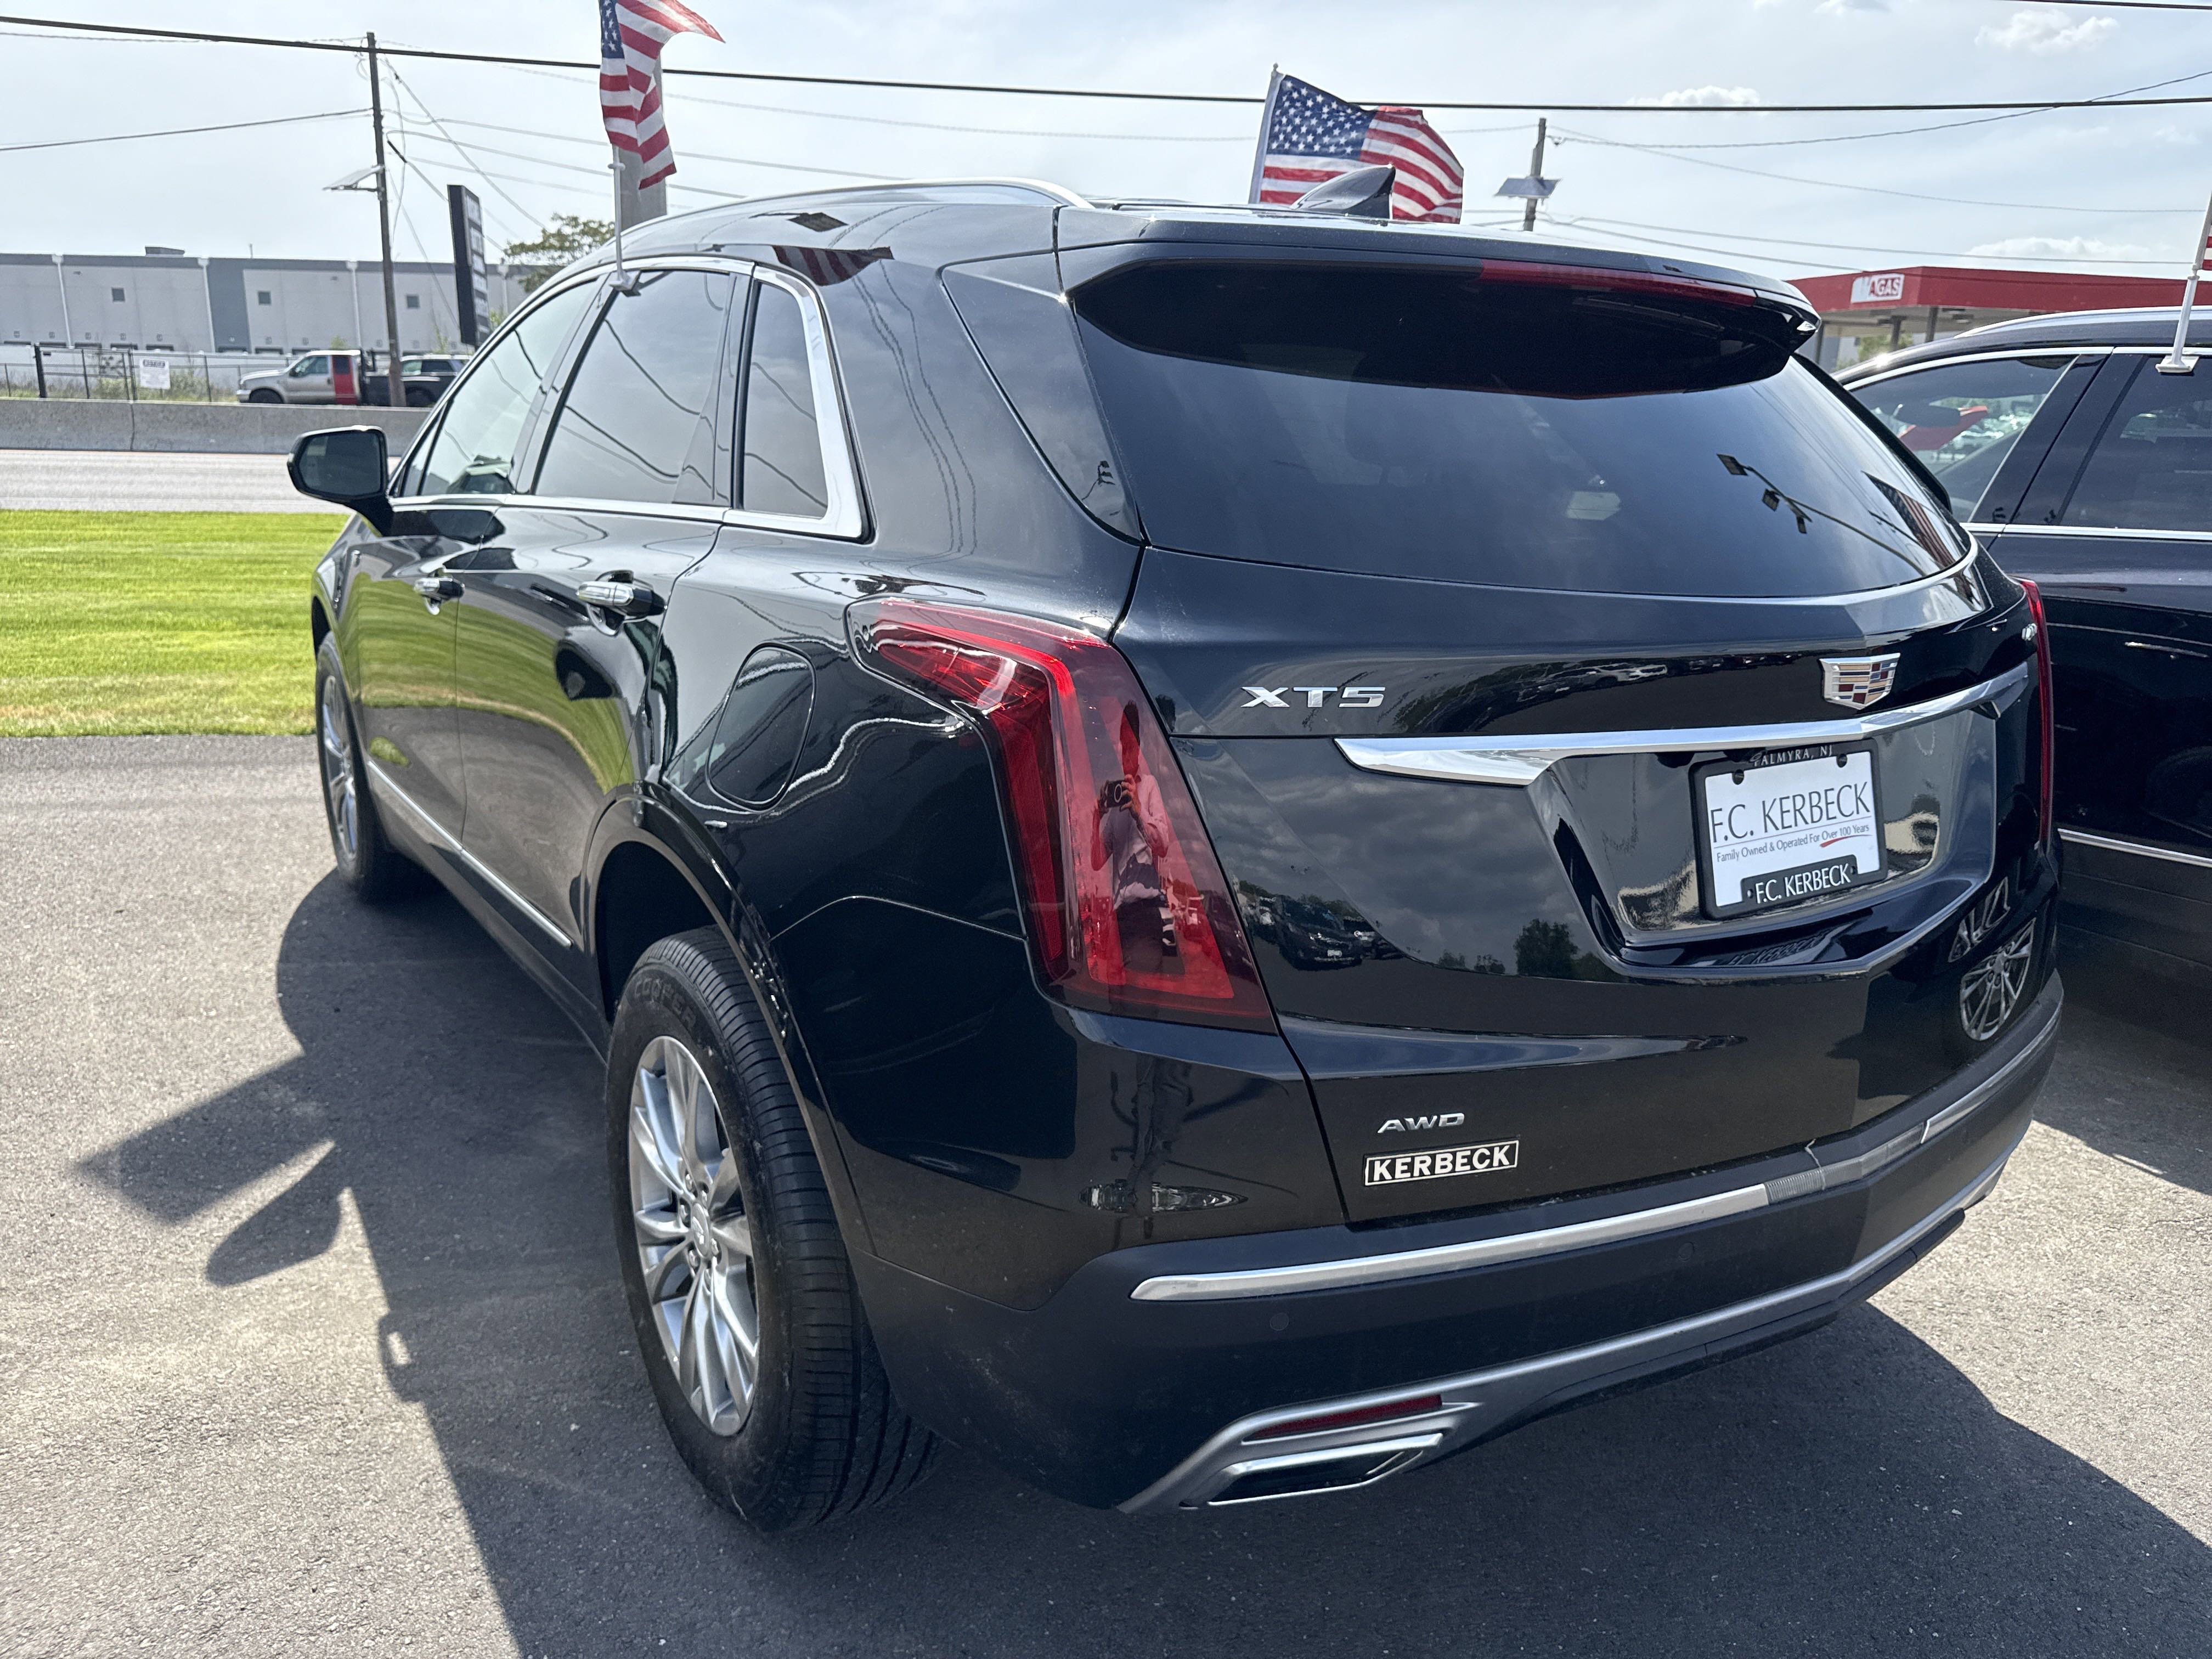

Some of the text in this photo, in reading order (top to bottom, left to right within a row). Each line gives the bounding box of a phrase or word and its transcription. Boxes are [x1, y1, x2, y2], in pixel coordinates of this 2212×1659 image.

[1240, 686, 1386, 708] XT5
[1820, 744, 1832, 757] NJ
[1710, 781, 1871, 843] F.C. KERBECK
[1716, 823, 1870, 863] Family Owned & Operated For Over 100 Years
[1755, 863, 1852, 904] F.C. KERBECK
[634, 977, 698, 1029] COOPER
[1377, 1113, 1465, 1133] AWD
[1373, 1144, 1510, 1182] KERBECK
